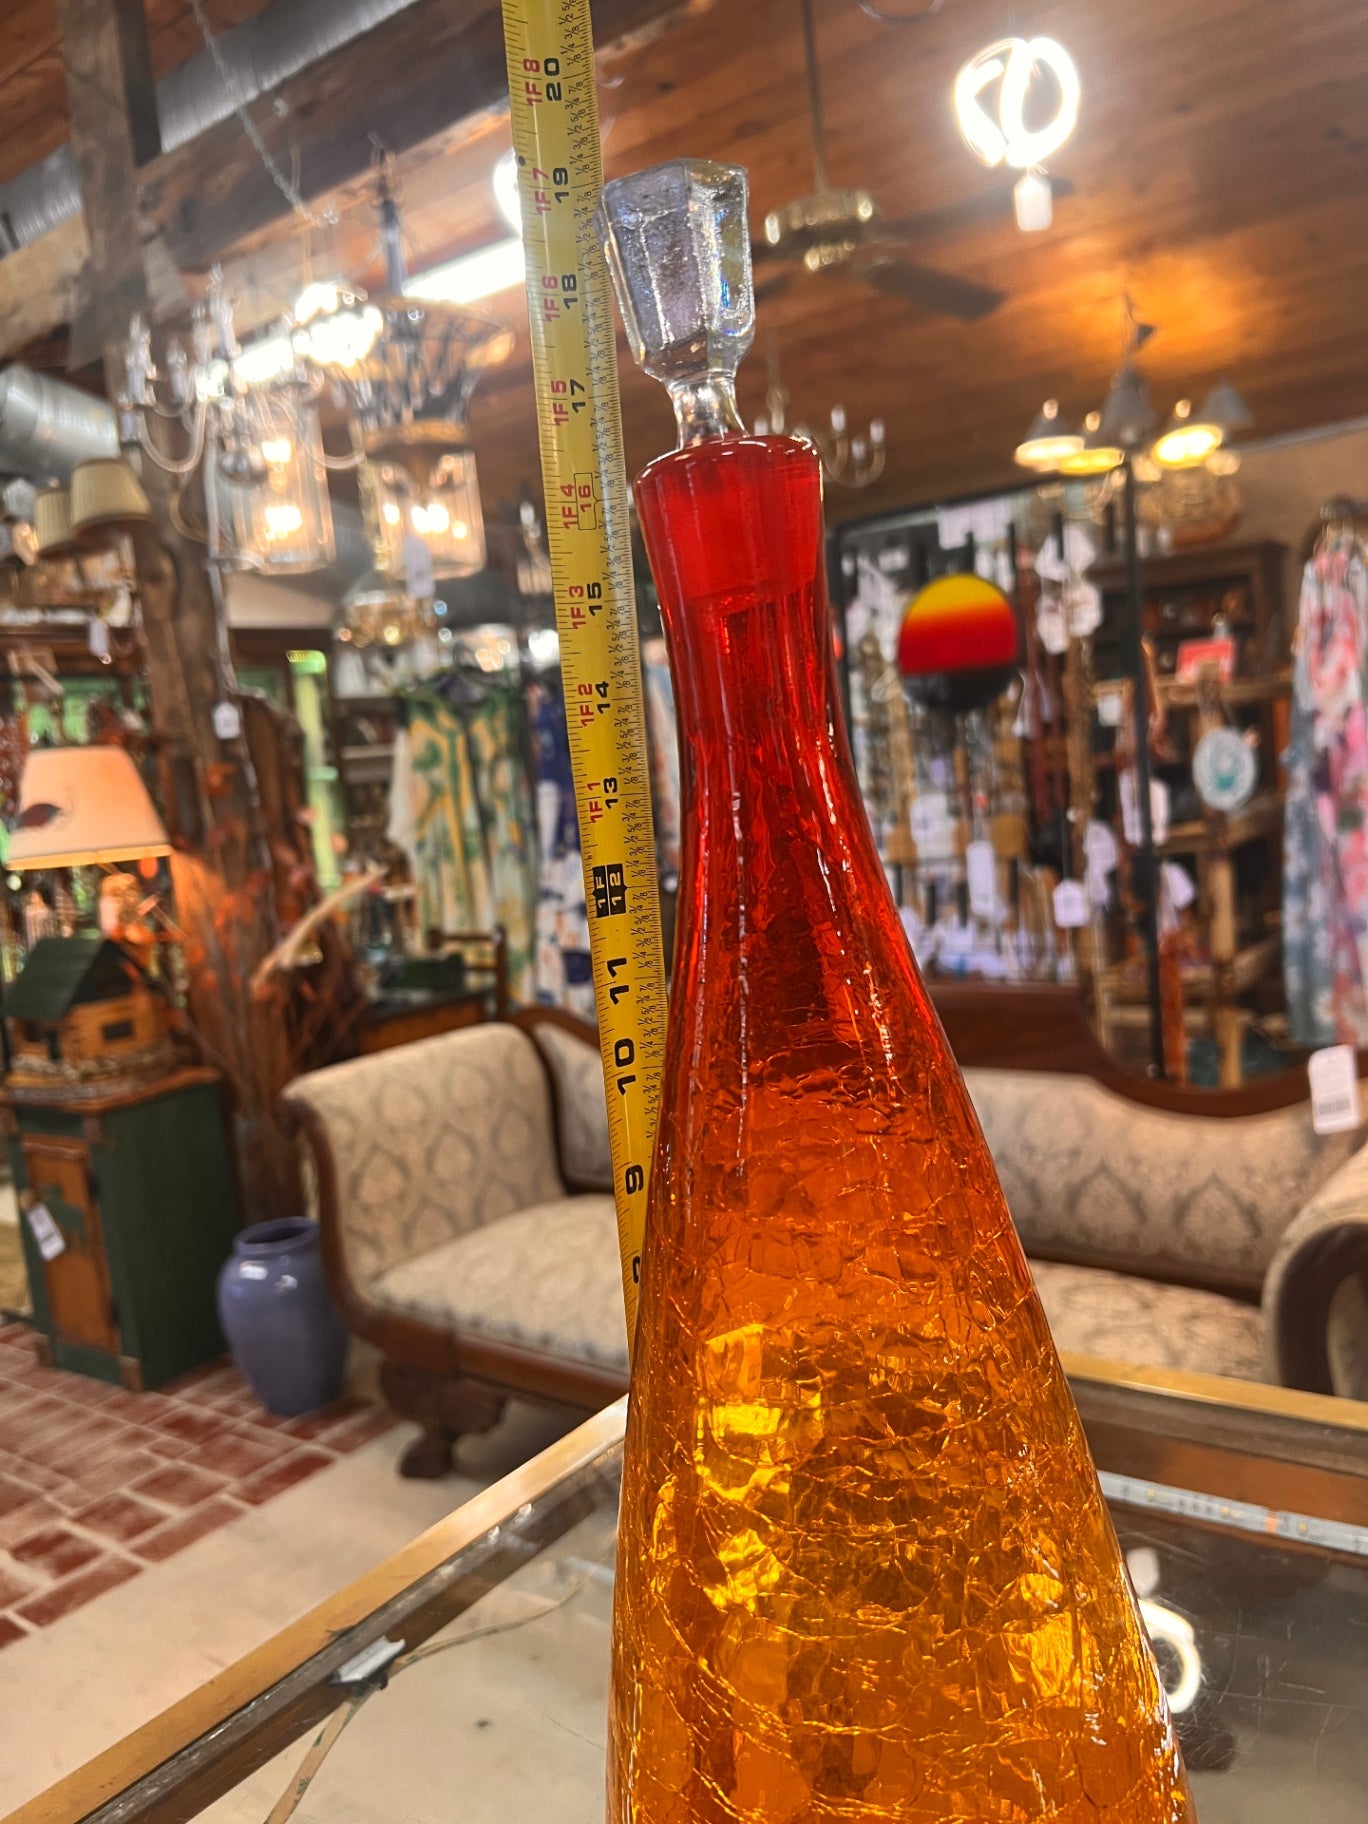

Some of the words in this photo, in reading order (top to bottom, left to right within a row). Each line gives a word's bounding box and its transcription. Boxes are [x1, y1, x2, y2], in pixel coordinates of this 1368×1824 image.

[543, 57, 562, 102] 20
[552, 167, 570, 204] 19
[561, 274, 578, 309] 18
[570, 379, 586, 413] 17
[578, 485, 592, 513] 16
[587, 582, 602, 616] 15
[595, 681, 611, 714] 14
[603, 777, 618, 810] 13
[610, 872, 622, 906] 12
[607, 957, 630, 1005] 11
[614, 1038, 636, 1096] 10
[625, 1164, 644, 1195] 9
